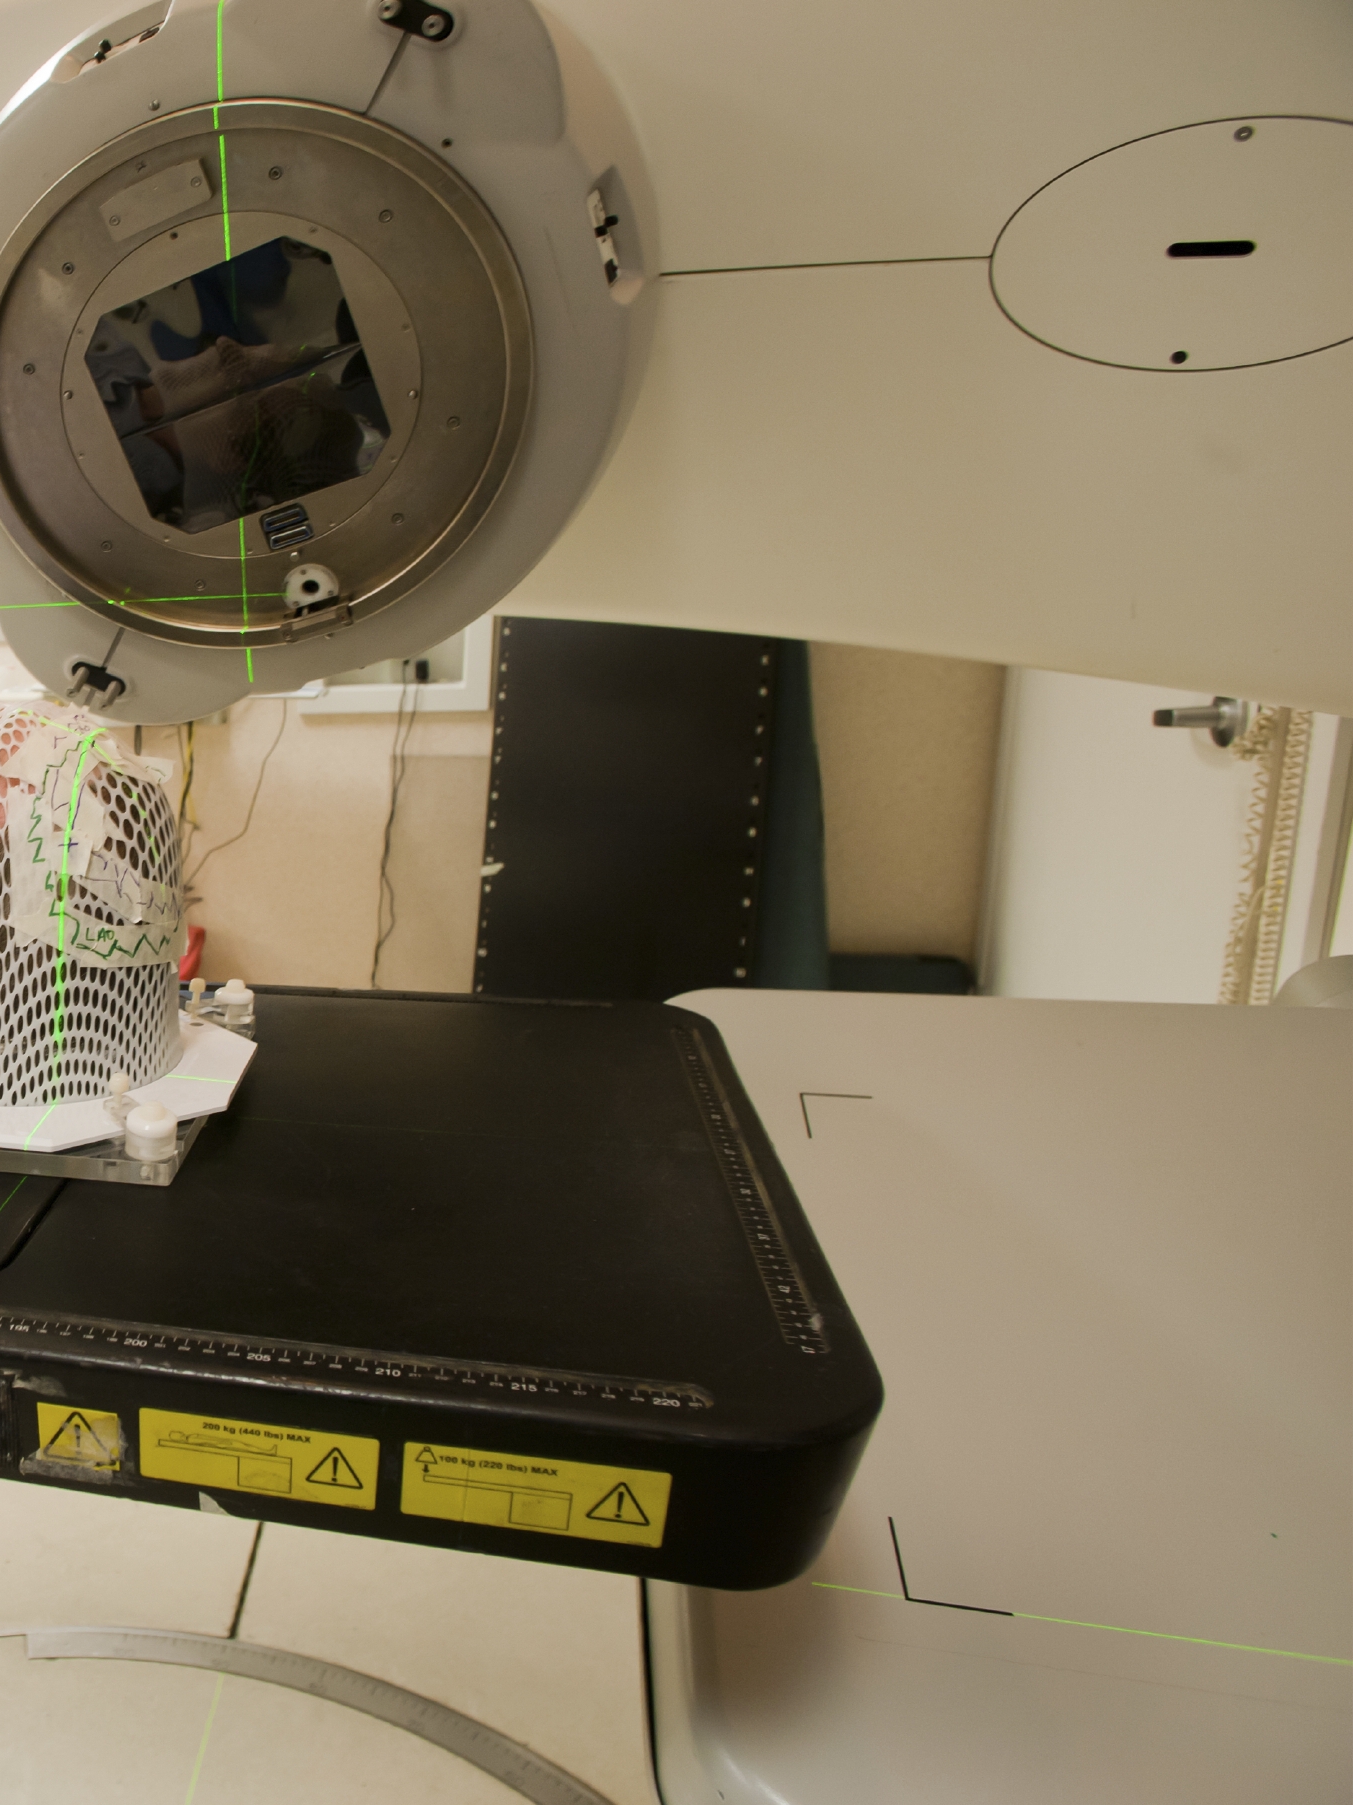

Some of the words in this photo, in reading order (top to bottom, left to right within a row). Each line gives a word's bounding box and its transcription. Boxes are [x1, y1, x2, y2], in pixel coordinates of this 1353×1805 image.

[123, 1337, 148, 1348] 200
[246, 1351, 272, 1362] 205
[374, 1366, 402, 1378] 210
[510, 1382, 538, 1392] 215
[652, 1397, 681, 1408] 220
[202, 1421, 221, 1432] 200
[223, 1425, 236, 1435] kg
[239, 1427, 261, 1437] (440
[263, 1430, 284, 1441] lbs)
[286, 1432, 311, 1444] MAX
[461, 1457, 476, 1468] kg
[479, 1459, 504, 1470] (220
[506, 1463, 528, 1474] lbs)
[530, 1466, 559, 1477] MAX
